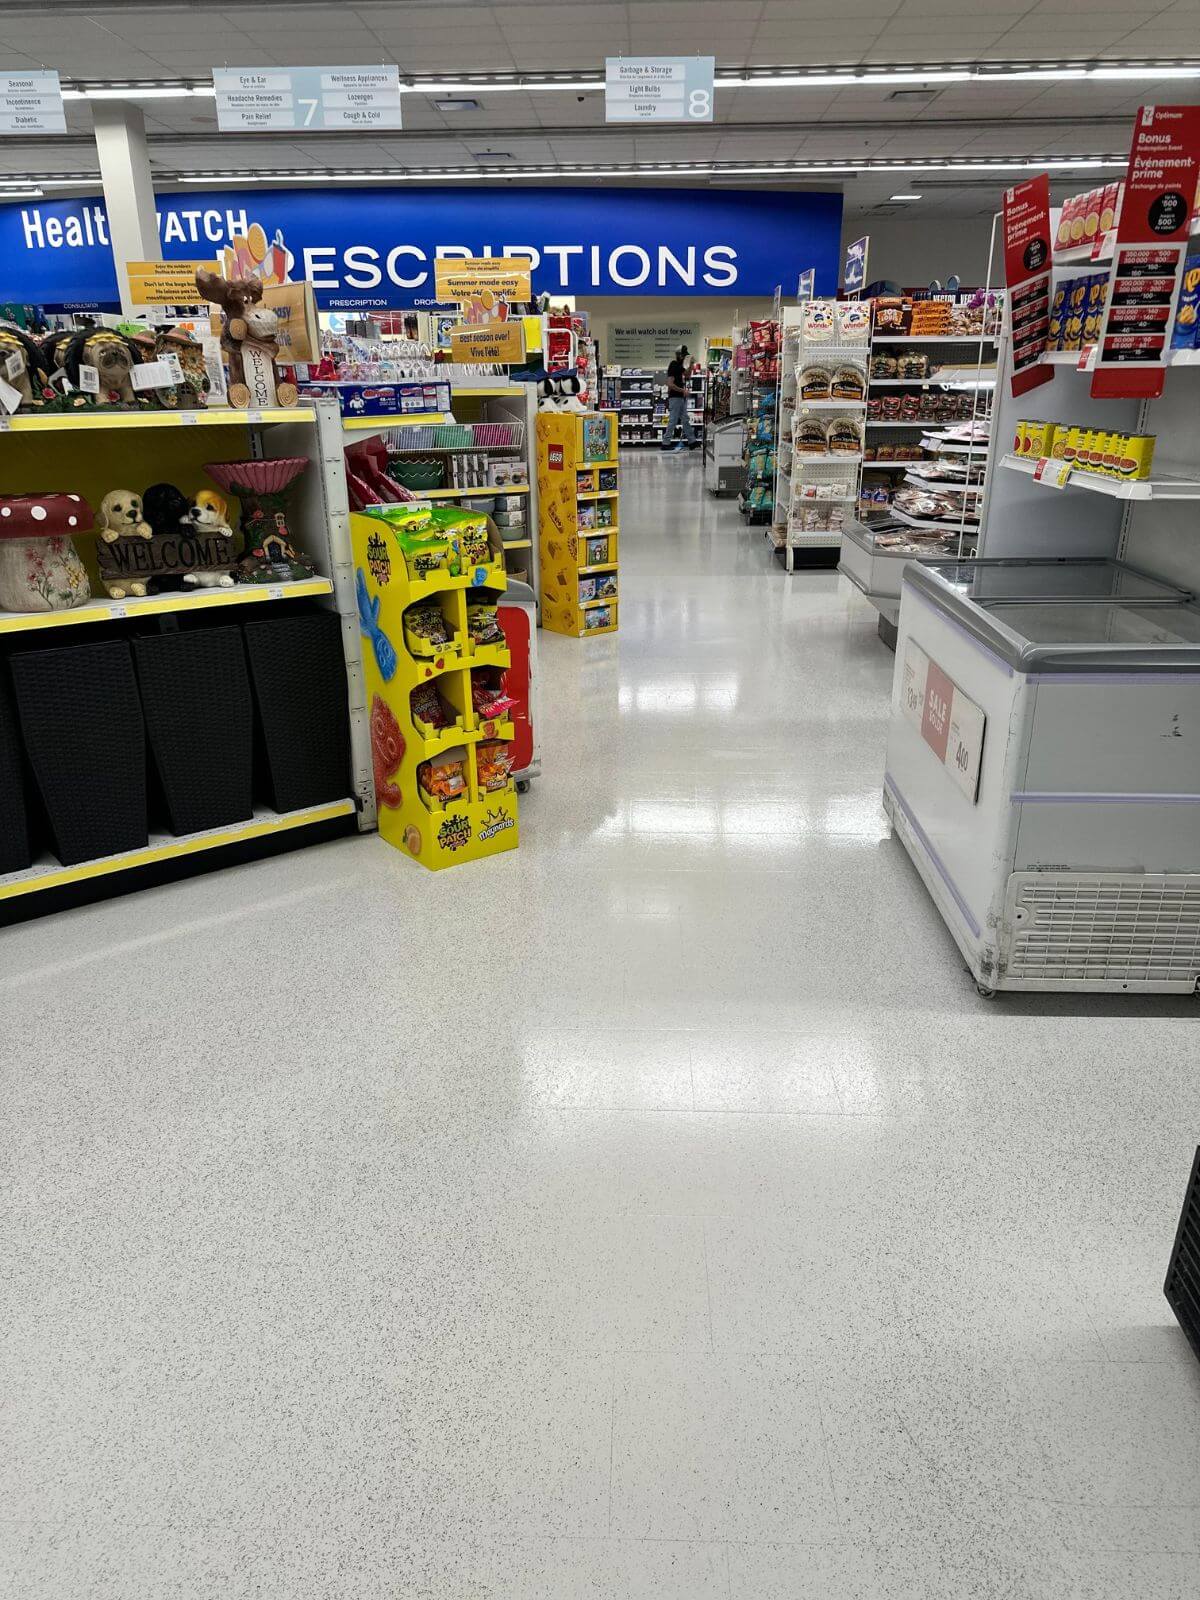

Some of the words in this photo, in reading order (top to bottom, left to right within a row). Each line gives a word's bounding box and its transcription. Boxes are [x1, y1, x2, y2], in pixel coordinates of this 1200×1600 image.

[619, 66, 643, 75] Garbage
[644, 66, 649, 74] &
[651, 66, 673, 75] Storage
[239, 76, 250, 84] Eye
[257, 76, 266, 84] Ear
[357, 75, 389, 83] Appliances
[8, 80, 34, 88] Seasonal
[629, 85, 644, 94] Light
[644, 85, 661, 93] Bulbs
[6, 98, 42, 106] Incontinence
[227, 94, 254, 102] Headache
[255, 94, 283, 102] Remedies
[347, 93, 374, 102] Lozenges
[634, 103, 656, 112] Laundry
[688, 89, 710, 118] 8
[297, 98, 319, 126] 7
[343, 111, 361, 120] Cough
[368, 111, 381, 119] Cold
[1155, 111, 1184, 120] Optimum
[1138, 132, 1171, 144] Bonus
[1132, 167, 1163, 182] prime
[21, 206, 110, 249] Healt
[155, 209, 249, 243] ATCH
[501, 279, 519, 288] easy
[450, 289, 471, 297] Votre
[329, 299, 388, 307] PRESCRIPTION
[472, 334, 493, 342] season
[470, 346, 485, 357] Vive
[248, 350, 269, 407] WELCOME
[549, 452, 563, 462] LEGO
[108, 536, 231, 573] WELCOME
[367, 545, 388, 560] SOUR
[369, 559, 391, 576] PATCH
[929, 689, 947, 722] SALE
[439, 819, 470, 838] SOUR
[439, 827, 472, 849] PATCH
